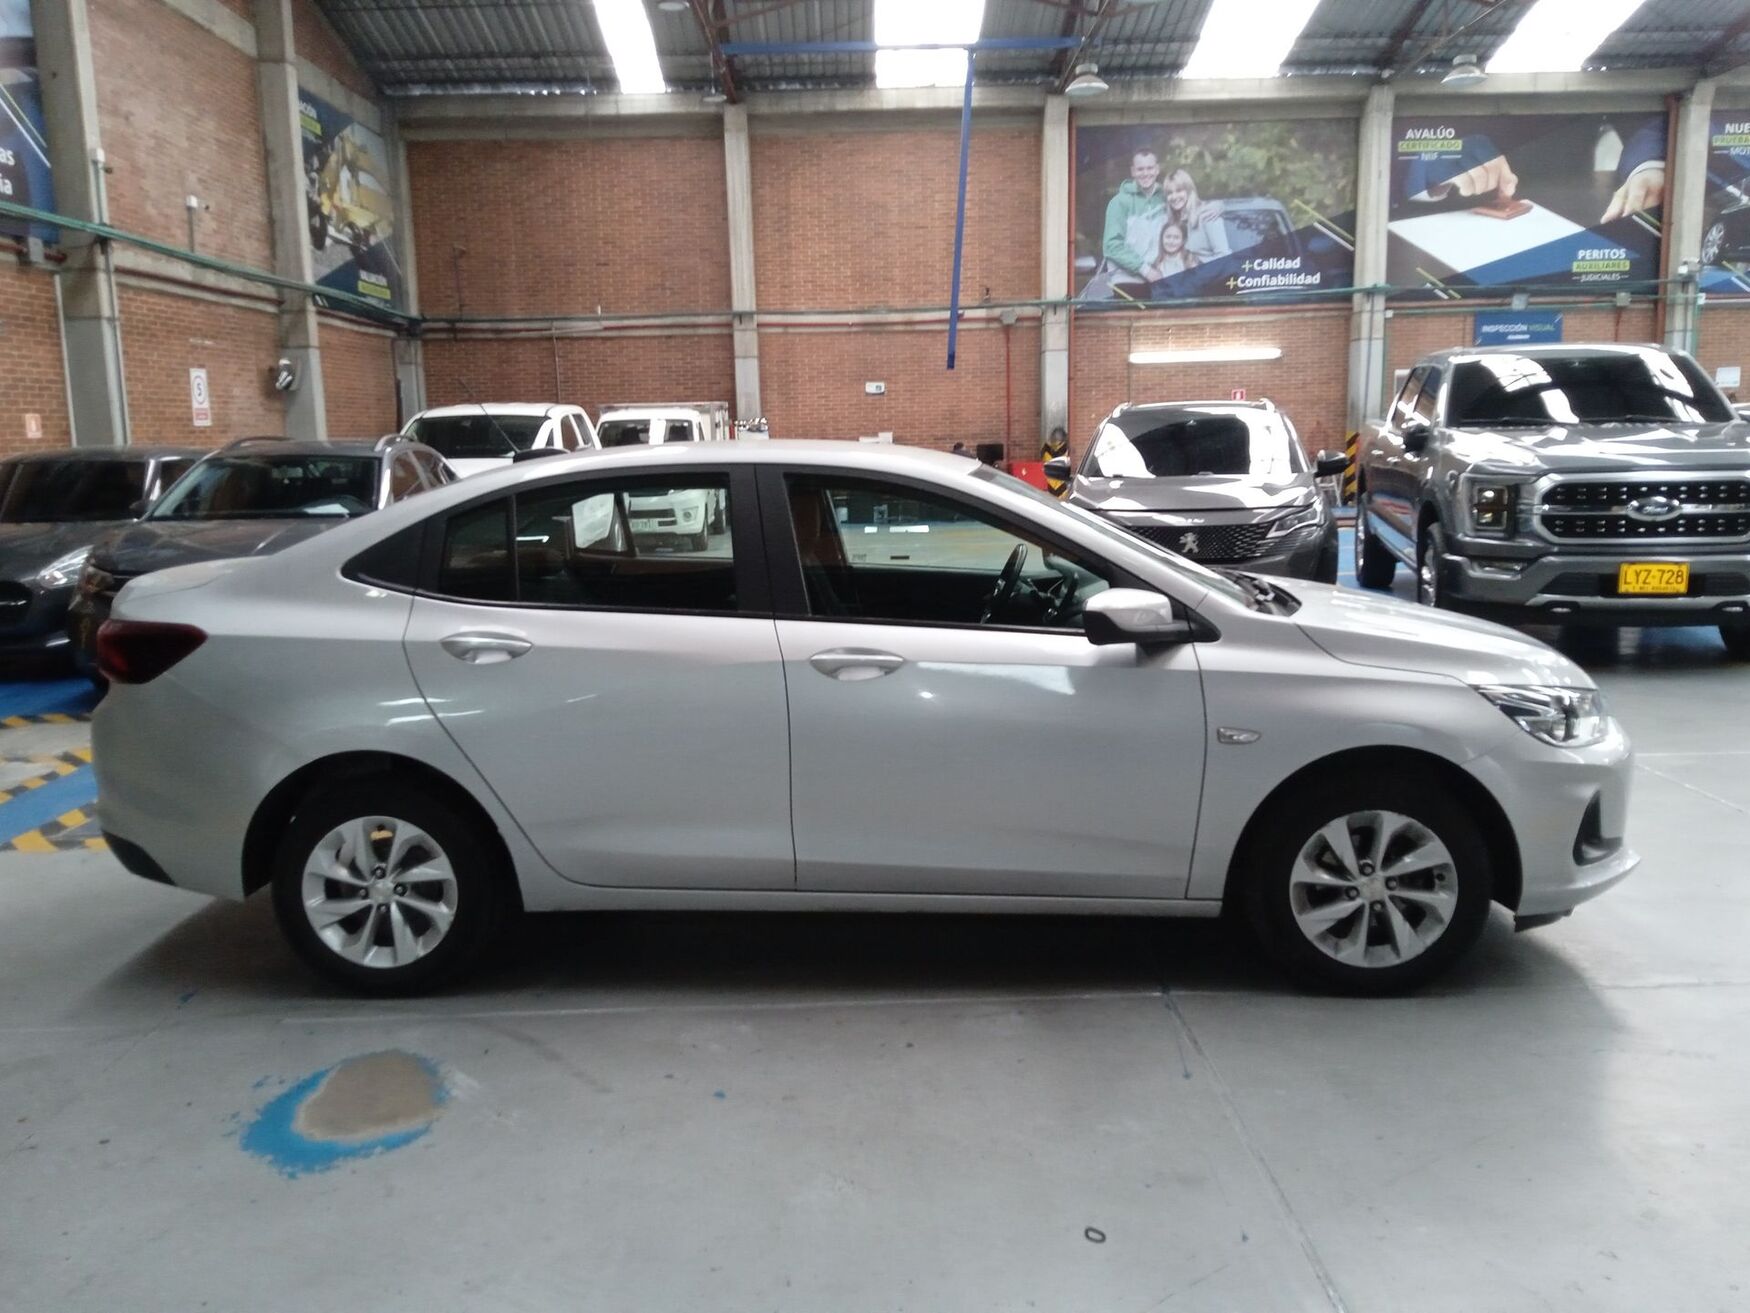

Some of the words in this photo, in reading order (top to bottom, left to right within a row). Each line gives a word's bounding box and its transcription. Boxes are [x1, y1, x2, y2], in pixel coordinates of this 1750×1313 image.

[1405, 125, 1456, 139] AVALÚO
[1399, 140, 1461, 151] CERTIFICADO
[1577, 248, 1627, 260] PERITOS
[1575, 261, 1628, 271] AUXILIARES
[1580, 272, 1621, 282] JUDICIALES
